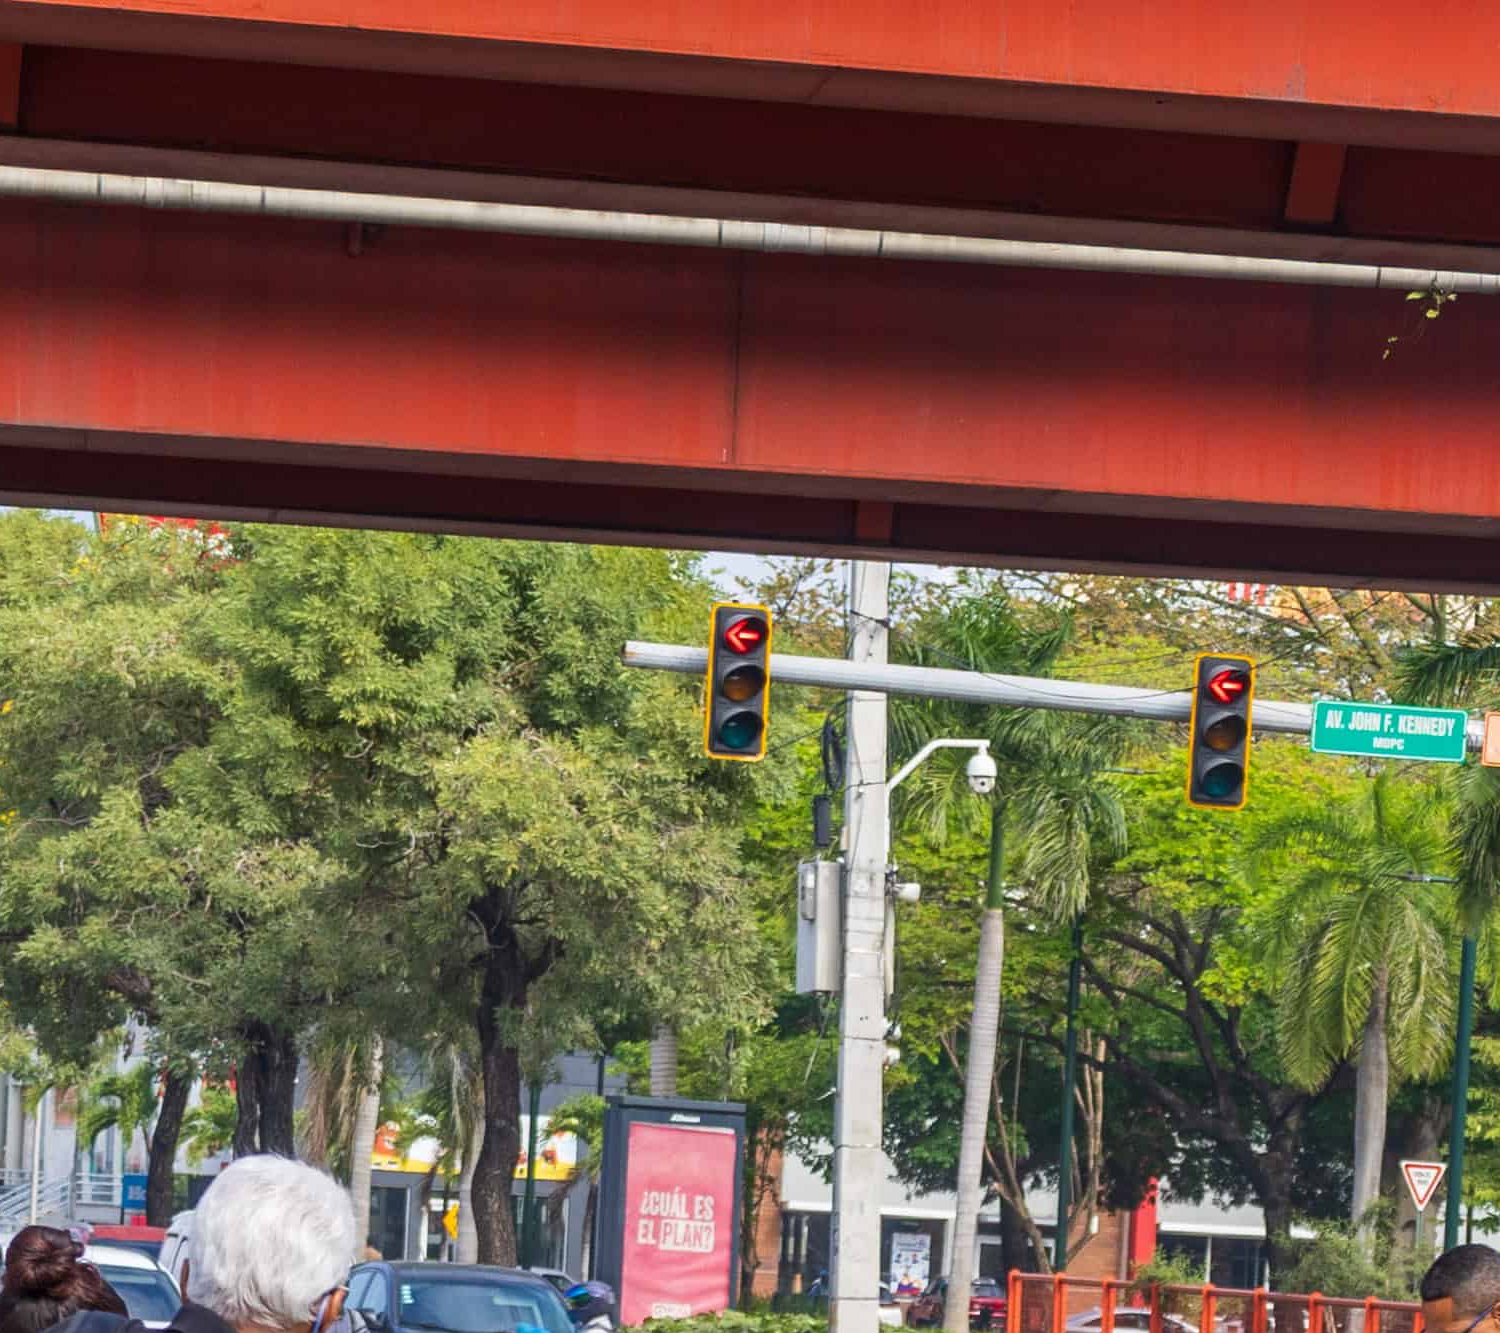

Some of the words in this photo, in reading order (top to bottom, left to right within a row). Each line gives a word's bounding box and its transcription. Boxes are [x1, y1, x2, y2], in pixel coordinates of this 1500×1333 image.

[1325, 710, 1345, 729] AV.
[1348, 711, 1381, 731] JOHN
[1384, 713, 1395, 733] F.
[1398, 714, 1456, 737] KENNEDY
[640, 1186, 690, 1218] ¿CUÁL
[693, 1194, 715, 1221] ES
[636, 1218, 657, 1244] EL
[662, 1221, 713, 1250] PLAN?
